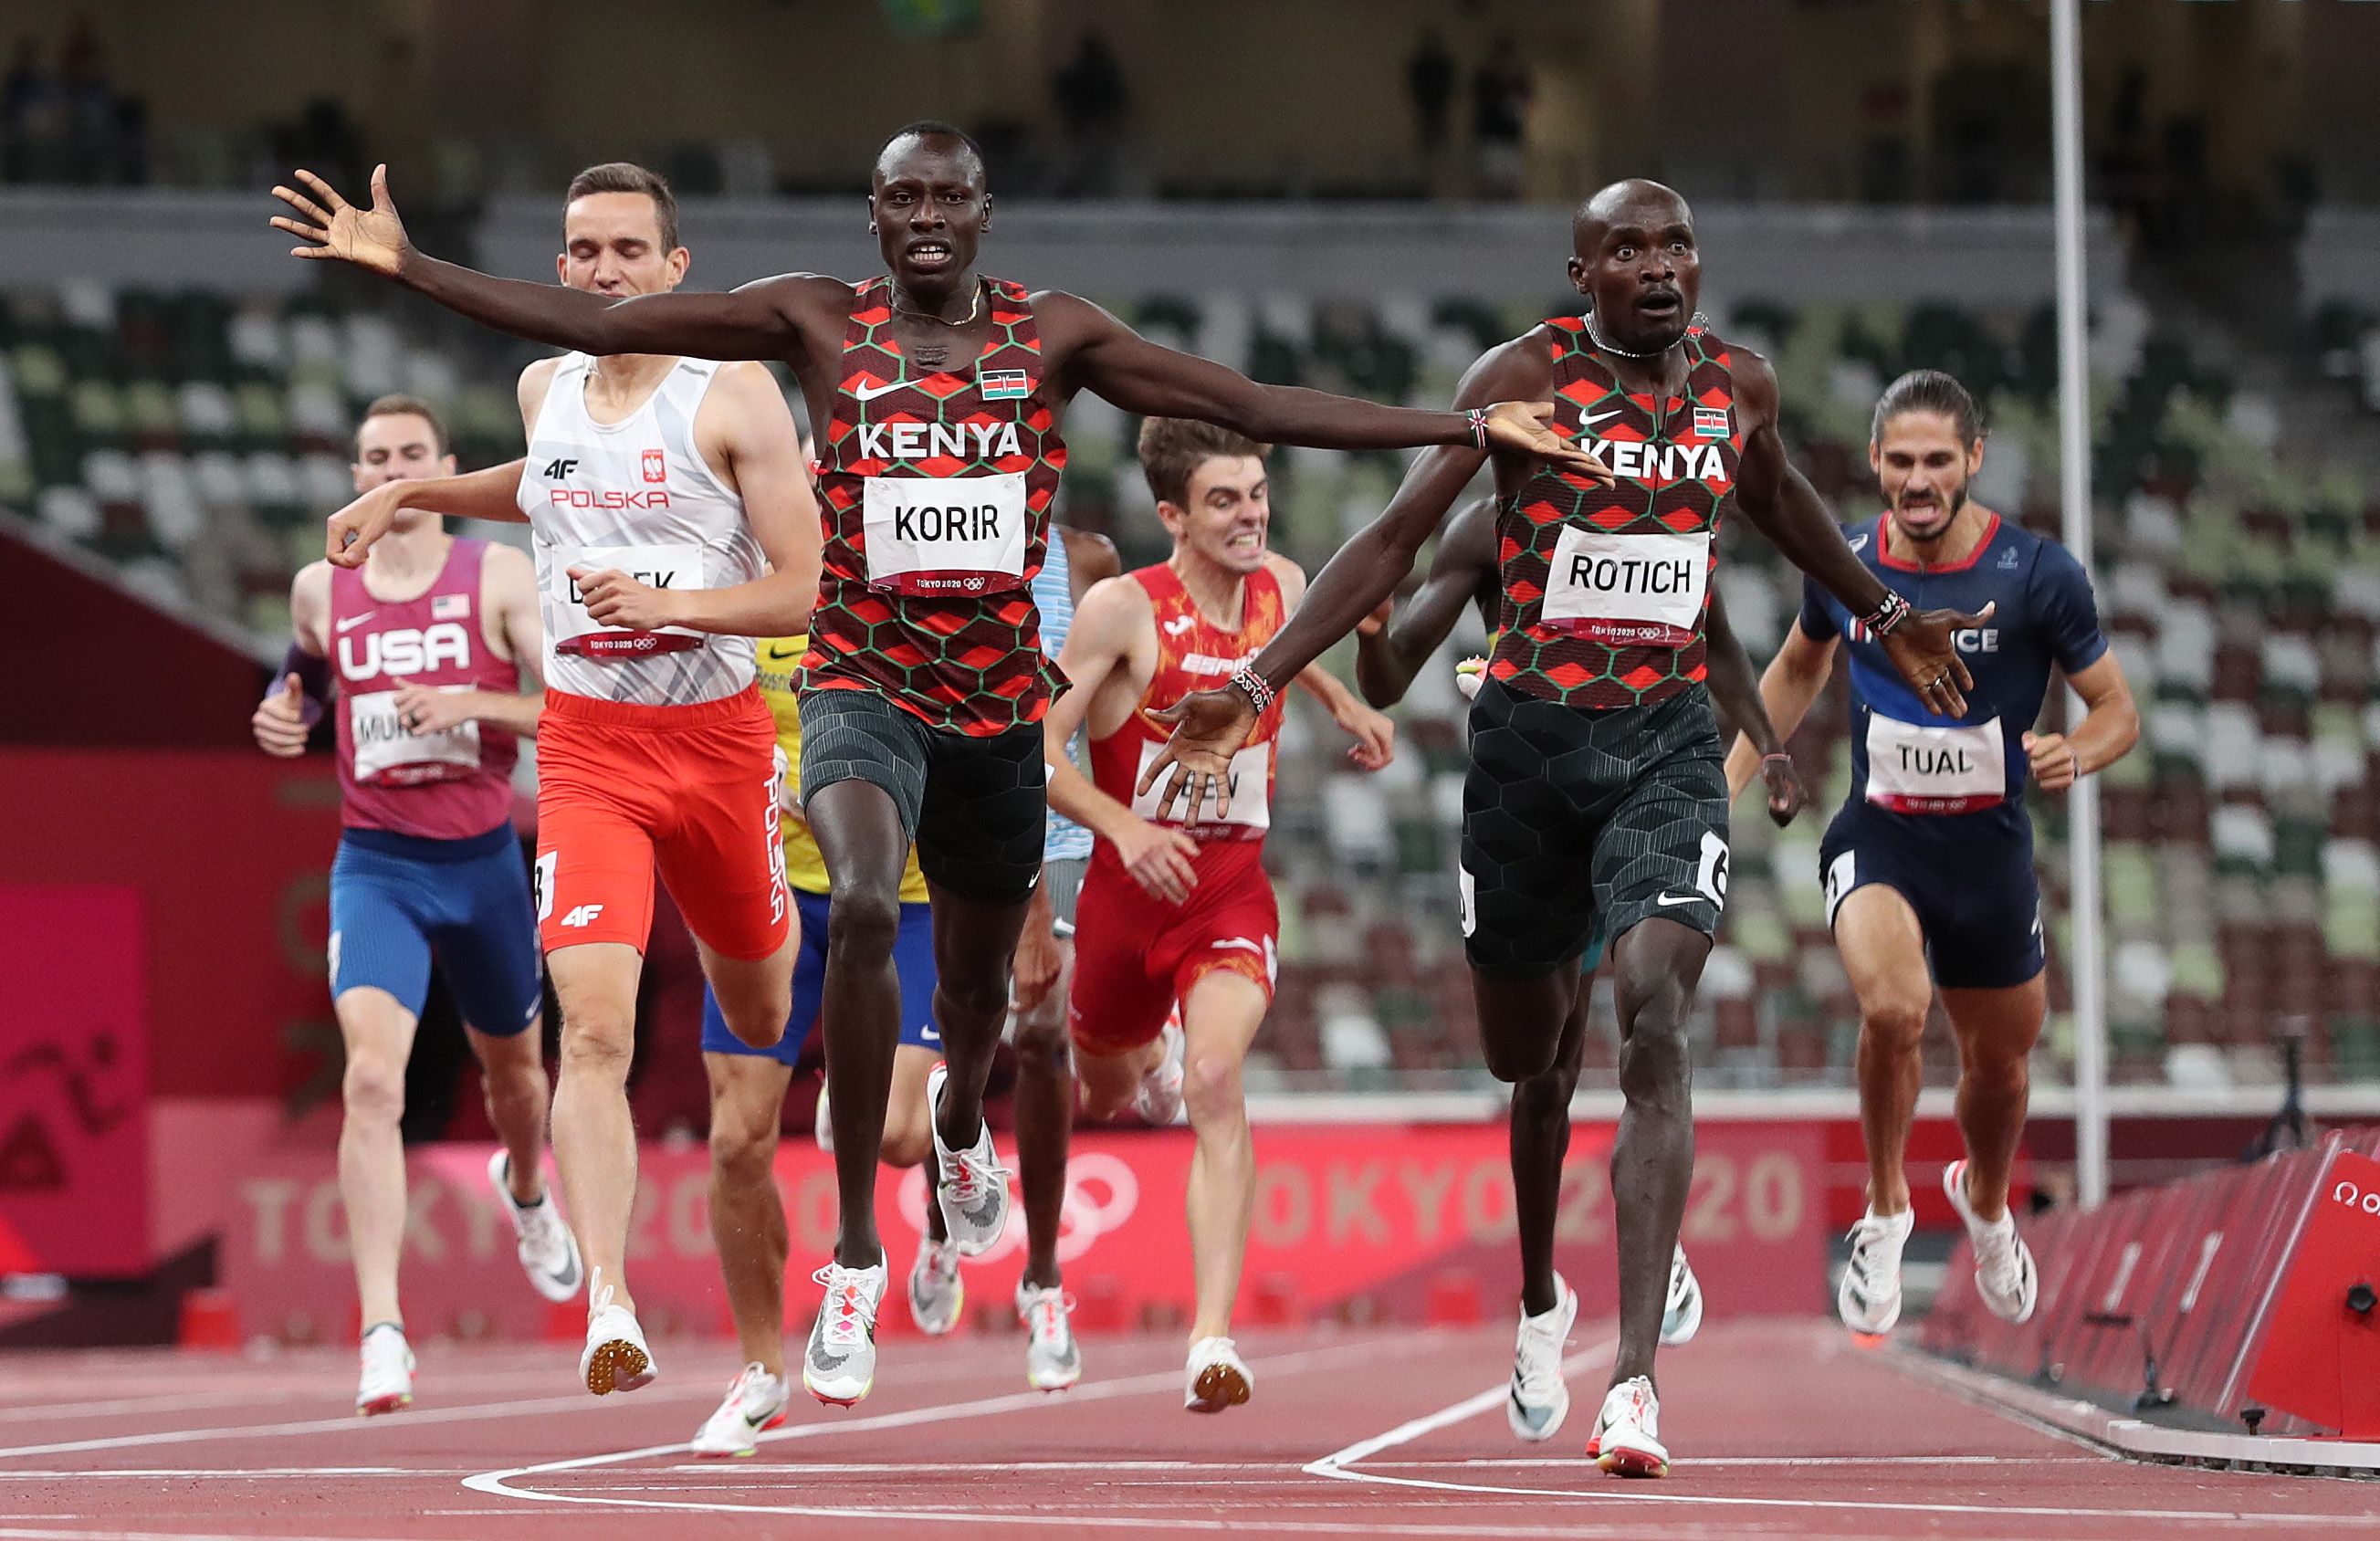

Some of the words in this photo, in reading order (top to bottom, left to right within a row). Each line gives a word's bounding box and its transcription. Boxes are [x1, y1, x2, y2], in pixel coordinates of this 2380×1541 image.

[858, 422, 1022, 459] KENYA
[1580, 438, 1725, 482] KENYA
[550, 489, 670, 509] POLSKA
[895, 504, 1000, 541] KORIR
[917, 579, 941, 589] TOKYO
[941, 580, 961, 589] 2020
[1567, 555, 1692, 593] ROTICH
[338, 623, 471, 681] USA
[1896, 743, 1974, 776] TUAL
[763, 776, 787, 926] POLSKA
